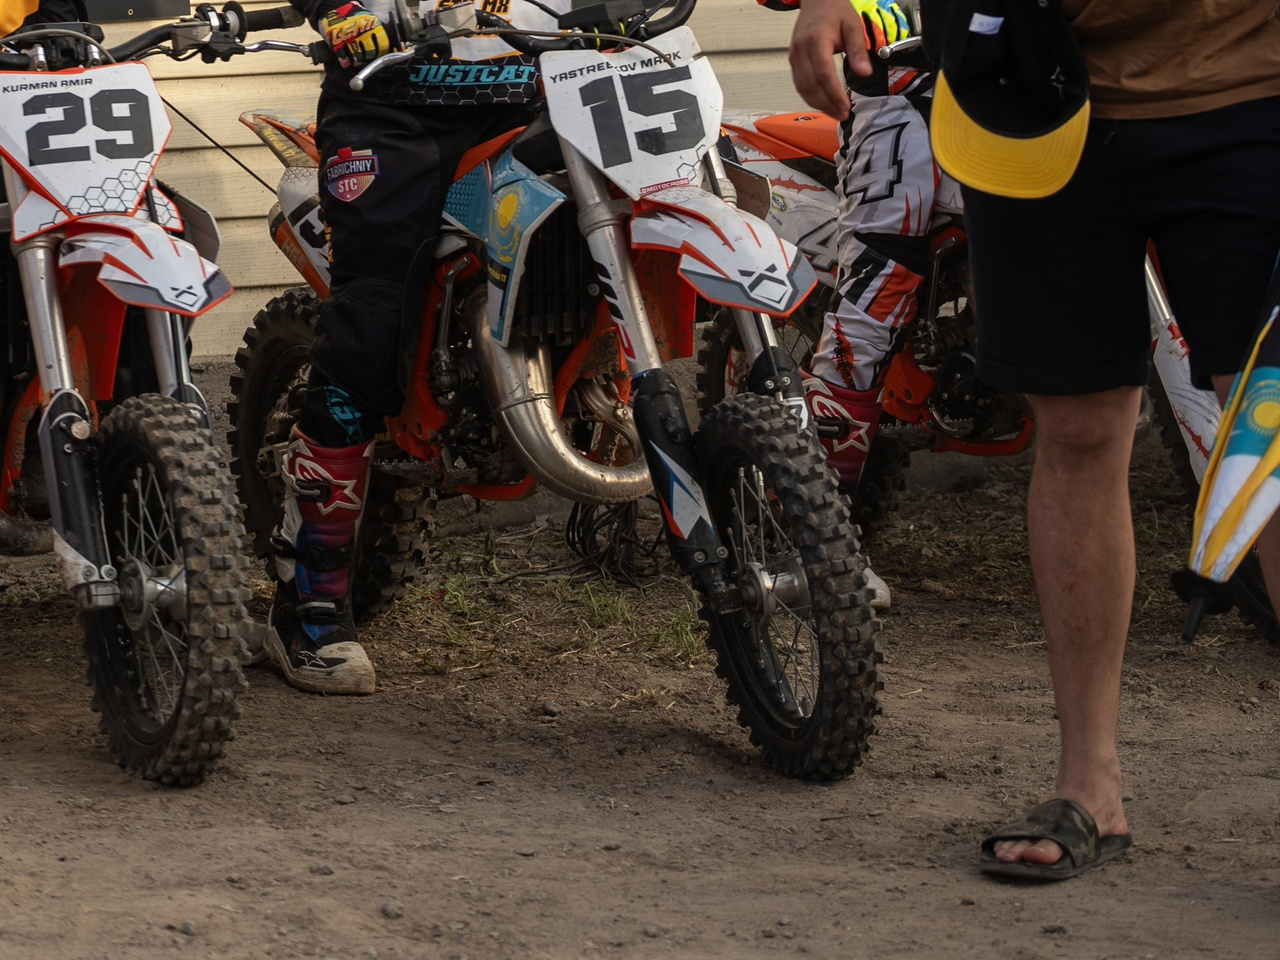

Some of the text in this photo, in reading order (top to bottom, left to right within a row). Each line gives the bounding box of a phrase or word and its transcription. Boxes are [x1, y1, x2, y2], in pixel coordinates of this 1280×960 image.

[409, 64, 536, 84] JUSTCAT
[2, 78, 93, 93] KURMAN AMIR
[578, 64, 707, 169] 15
[22, 88, 155, 167] 29
[326, 159, 373, 179] FABRICHNIY
[844, 121, 911, 206] 4
[338, 178, 358, 193] STC
[640, 178, 689, 194] #MOTOCROSS
[281, 238, 308, 274] HGS
